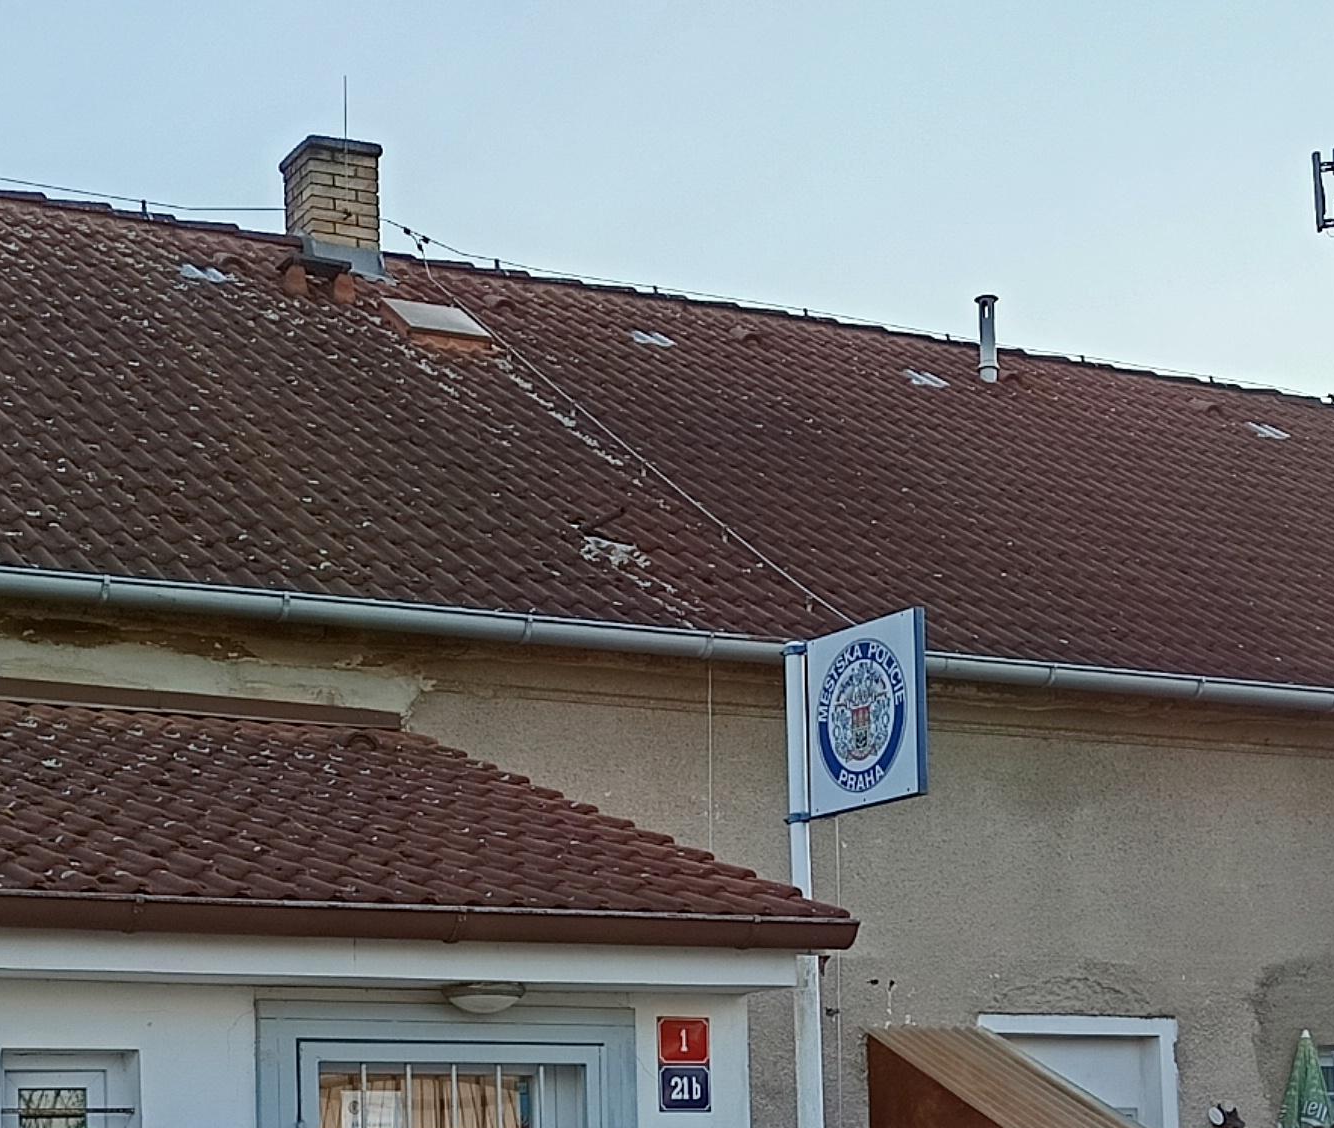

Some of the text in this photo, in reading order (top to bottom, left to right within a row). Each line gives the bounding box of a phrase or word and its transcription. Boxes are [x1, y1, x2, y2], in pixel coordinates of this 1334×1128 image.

[867, 641, 905, 706] POLICIE
[837, 768, 885, 790] PRAHA
[680, 1028, 689, 1052] 1
